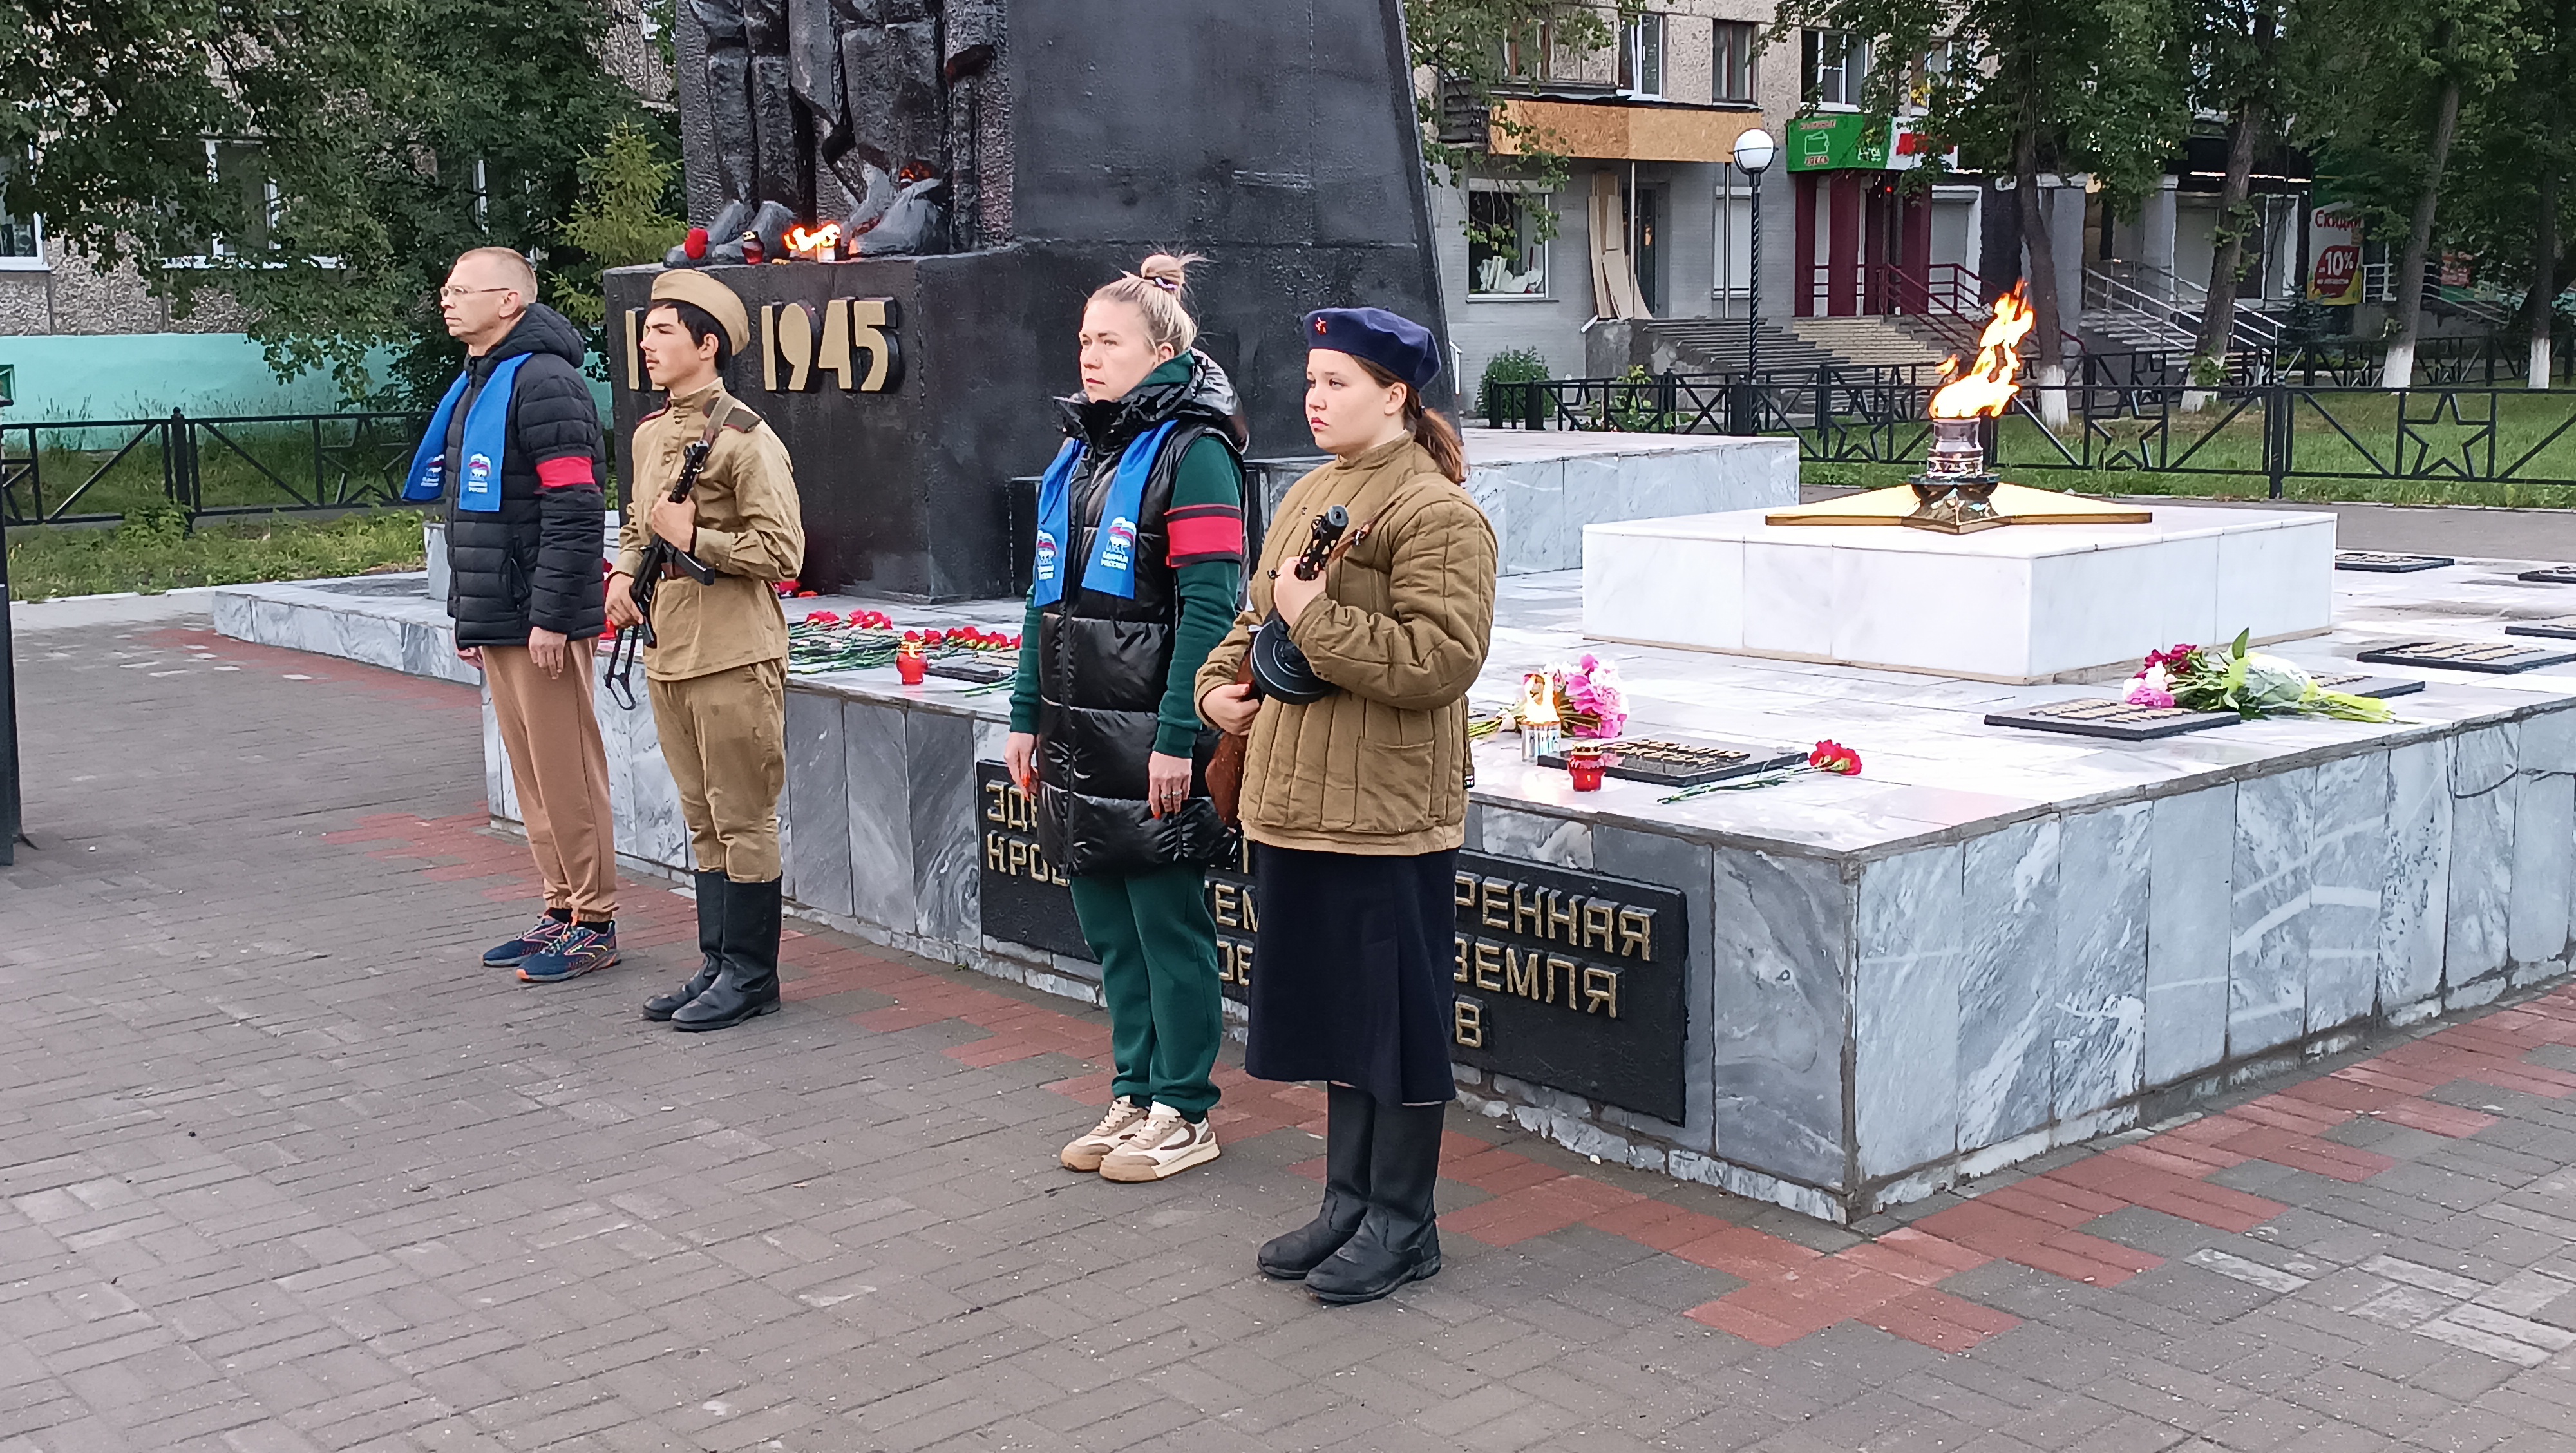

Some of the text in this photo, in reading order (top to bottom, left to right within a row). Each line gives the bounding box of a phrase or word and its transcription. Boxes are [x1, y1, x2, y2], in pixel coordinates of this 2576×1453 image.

[2325, 251, 2354, 276] 10%
[761, 298, 889, 391] 1945
[986, 783, 1651, 962] ЗДЕ РЕННАЯ
